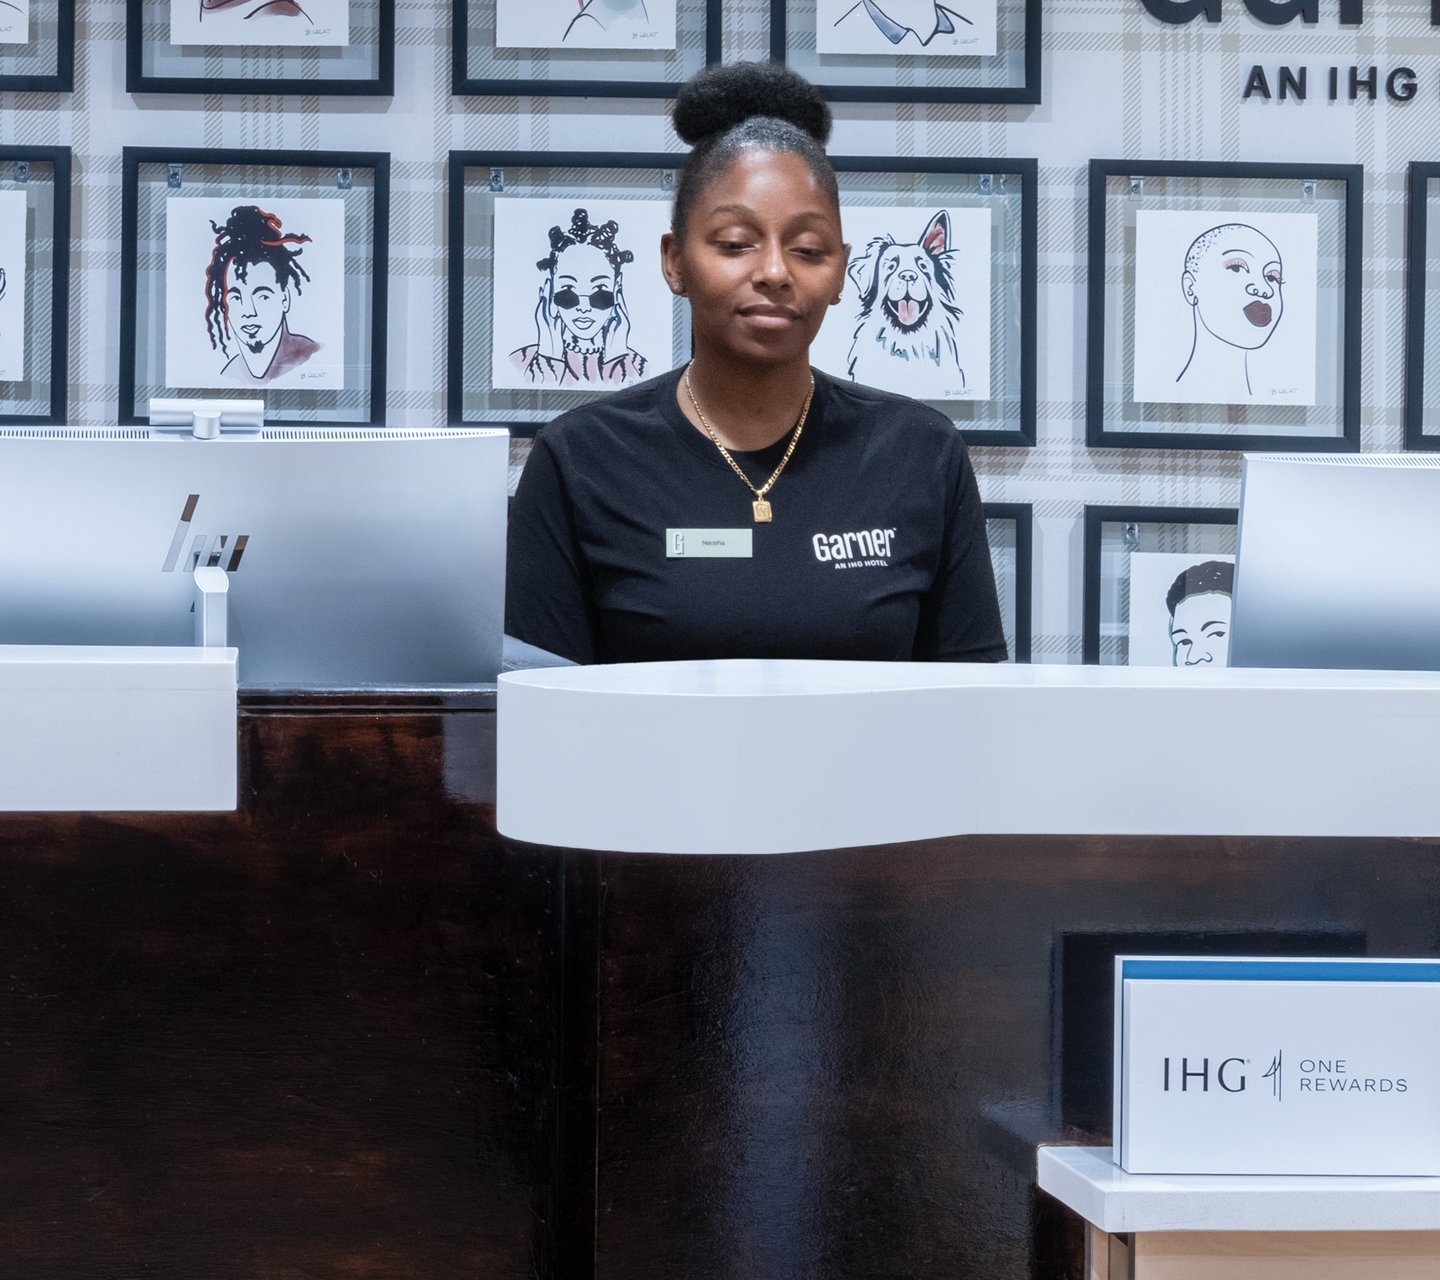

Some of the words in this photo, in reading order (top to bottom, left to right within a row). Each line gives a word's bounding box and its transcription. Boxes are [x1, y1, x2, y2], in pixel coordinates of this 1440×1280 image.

[1243, 65, 1308, 100] AN
[1329, 66, 1418, 102] IHG
[812, 528, 895, 562] Garner
[864, 559, 888, 567] HOTEL
[1164, 1057, 1246, 1093] IHG
[1300, 1059, 1347, 1073] ONE
[1300, 1078, 1408, 1093] REWARDS
